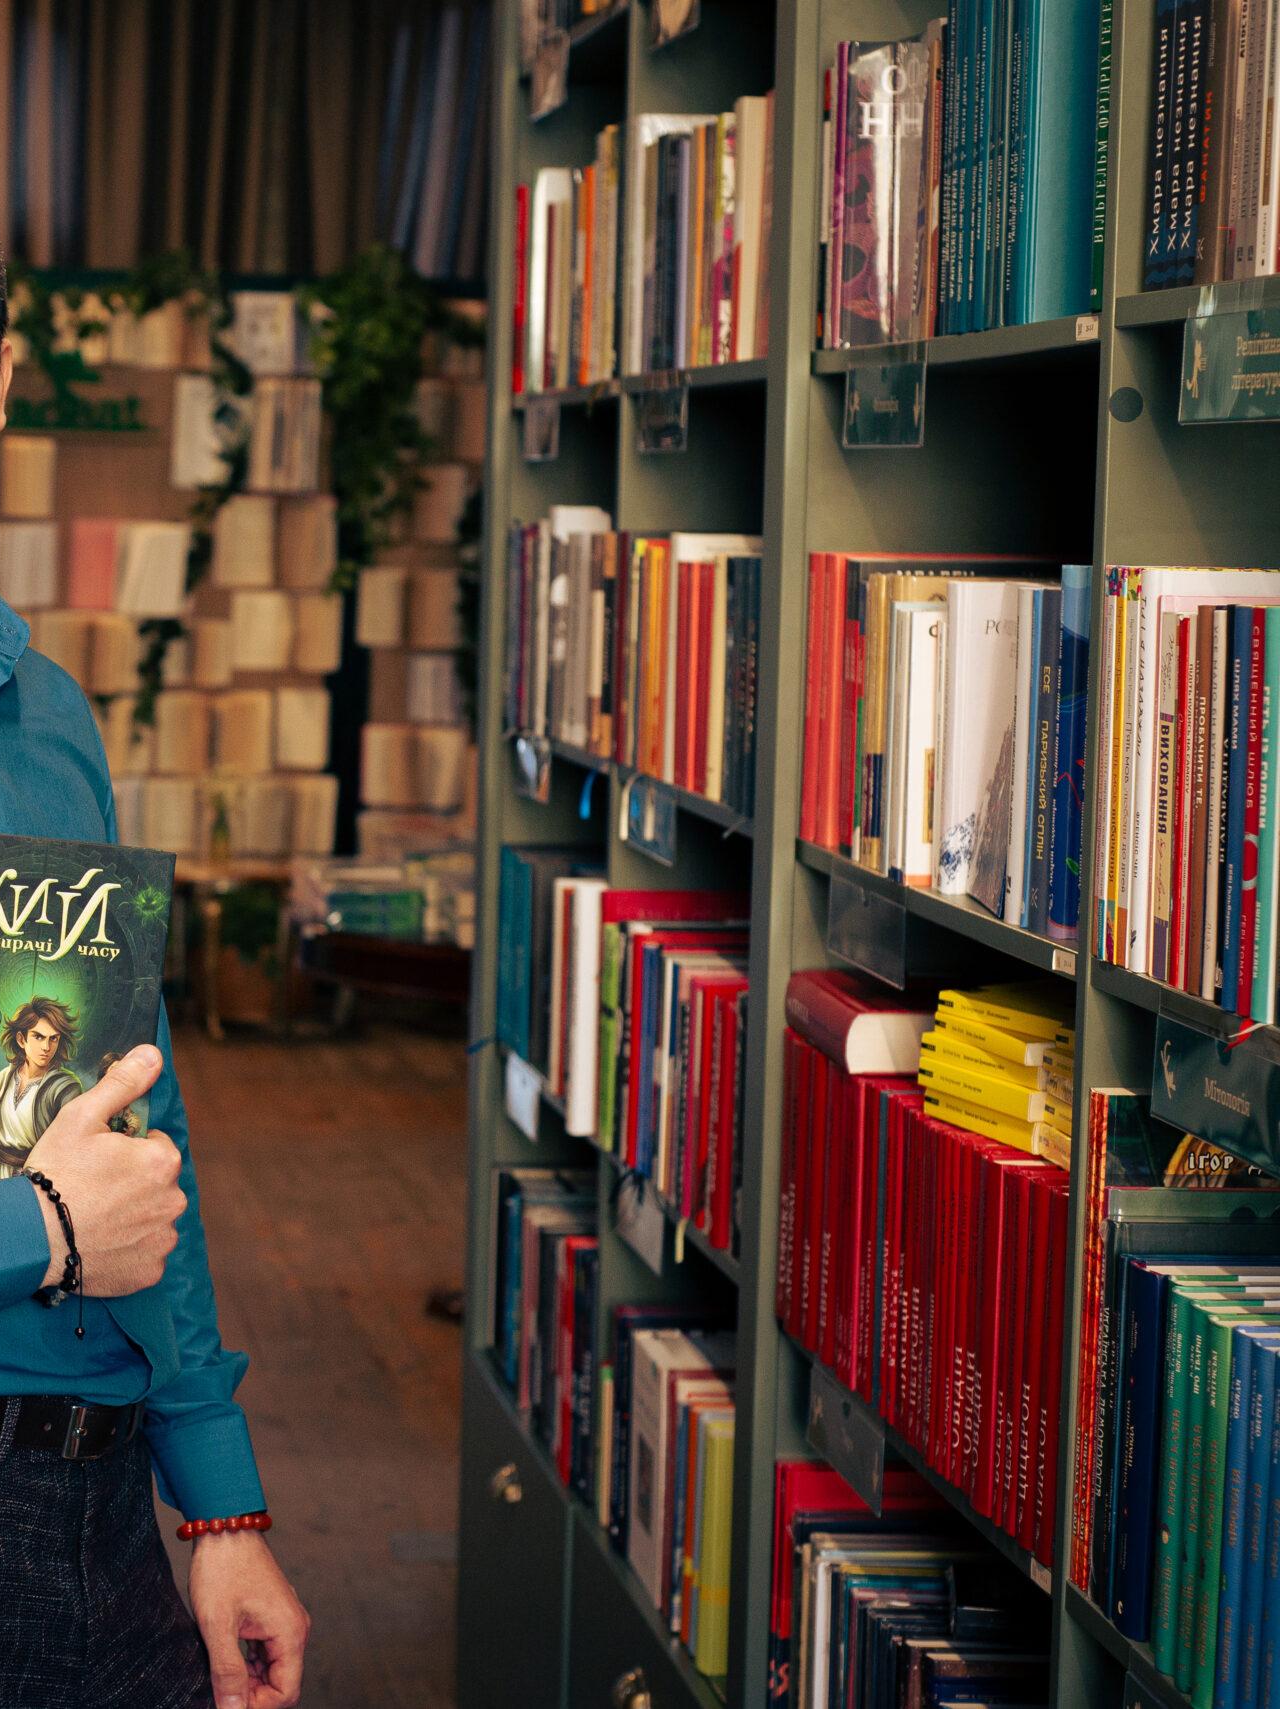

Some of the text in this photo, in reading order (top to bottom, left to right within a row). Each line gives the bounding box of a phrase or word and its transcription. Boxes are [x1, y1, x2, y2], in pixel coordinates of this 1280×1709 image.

[1097, 54, 1112, 129] ФРІДРІХ
[1149, 27, 1168, 256] Хмара незнання
[1167, 20, 1187, 253] Хмара незнання
[1181, 15, 1202, 249] Хмара незнання
[1093, 138, 1108, 244] ВІЛЬГЕЛЬМ
[1233, 658, 1241, 703] ШЛЯХ
[1246, 624, 1260, 809] СВЯЩЕННИЙ ШЛЮБ
[1036, 665, 1051, 860] ЕСЕ ПАРИЗЬКИЙ СПЛІН
[1158, 723, 1170, 834] ВИХОВАННЯ
[1197, 695, 1207, 783] ПРОБАЧИТИ
[1259, 685, 1271, 829] ГЕТЬ ІЗ ГОЛОВИ
[77, 944, 121, 962] часу
[1018, 1383, 1030, 1501] ЦІЦЕРОН
[1036, 1407, 1047, 1518] ПЛАТОН
[1095, 1397, 1106, 1498] ДЕМОНОЛОГІЯ
